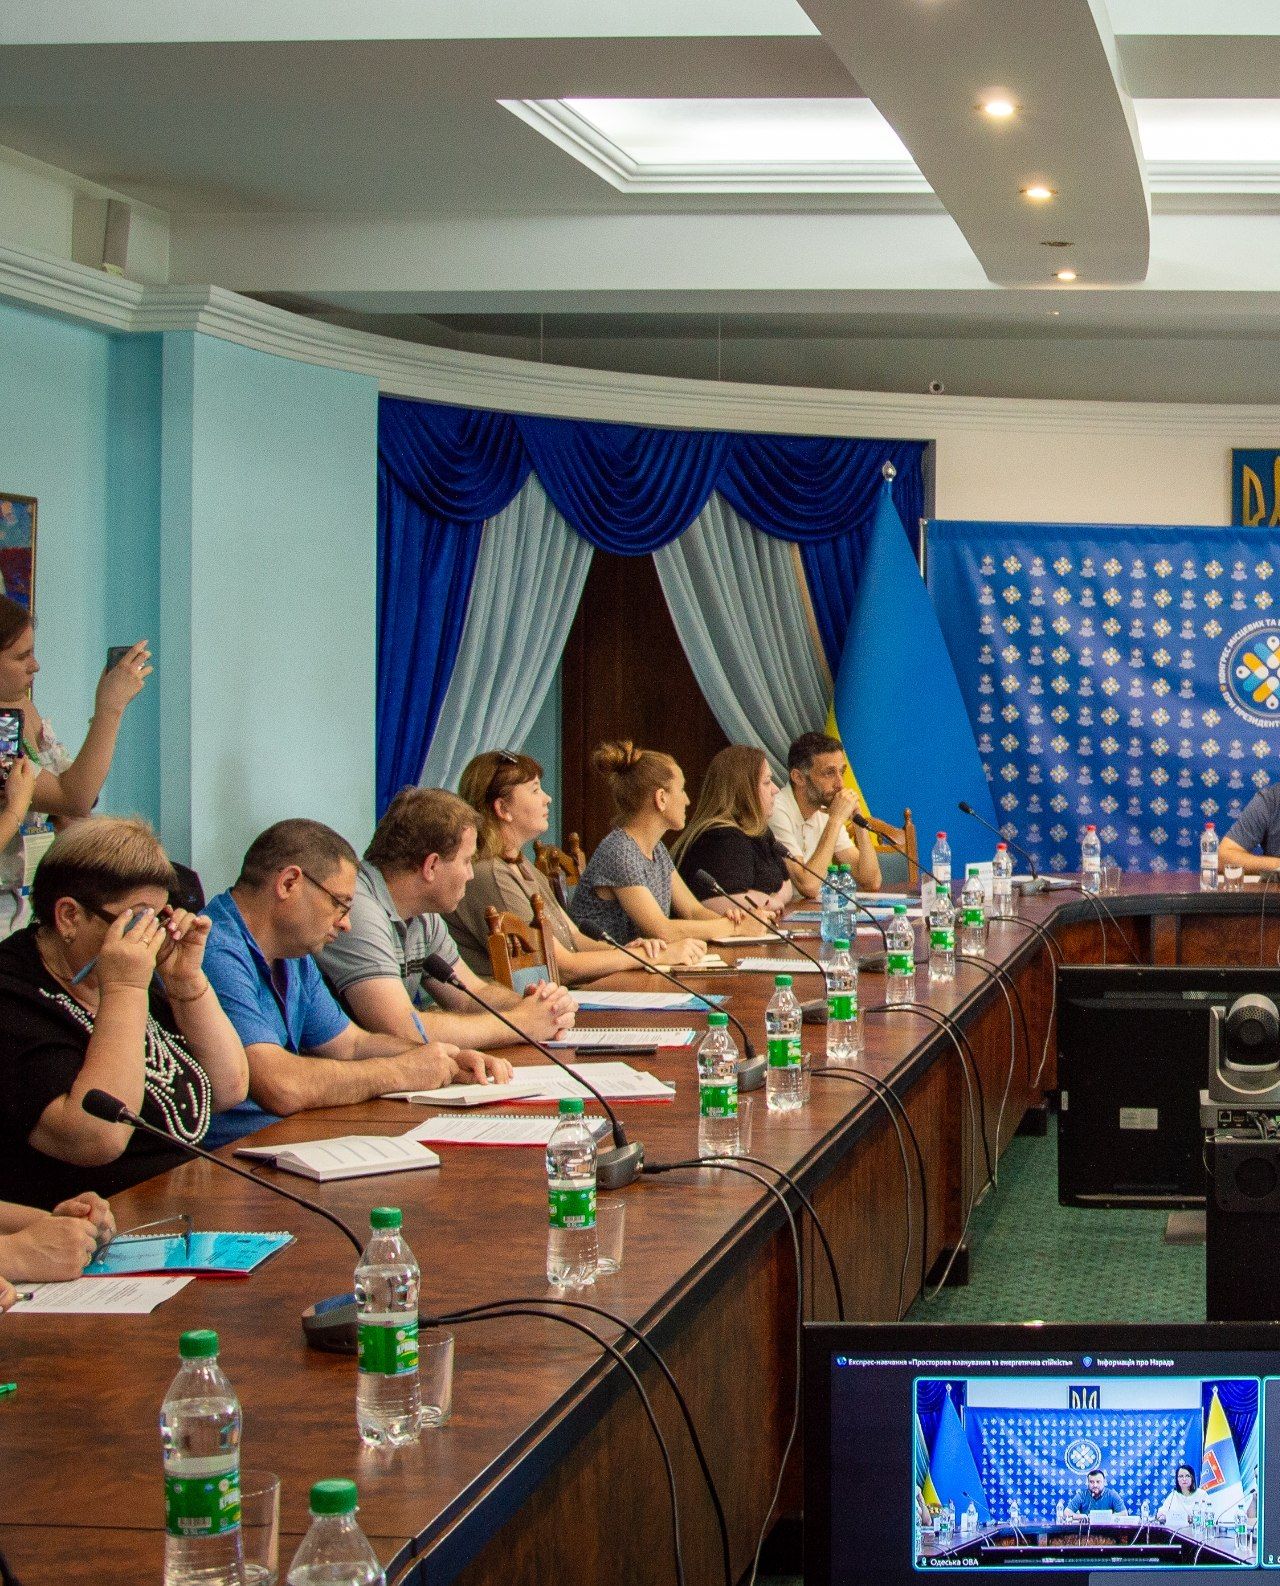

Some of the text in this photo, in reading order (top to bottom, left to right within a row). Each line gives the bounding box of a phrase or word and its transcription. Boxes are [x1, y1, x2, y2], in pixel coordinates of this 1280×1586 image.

[1227, 619, 1265, 648] МІСЦЕВИХ
[1265, 618, 1277, 627] ТА
[1136, 1358, 1149, 1367] про
[930, 1557, 979, 1567] Одеська ОВА
